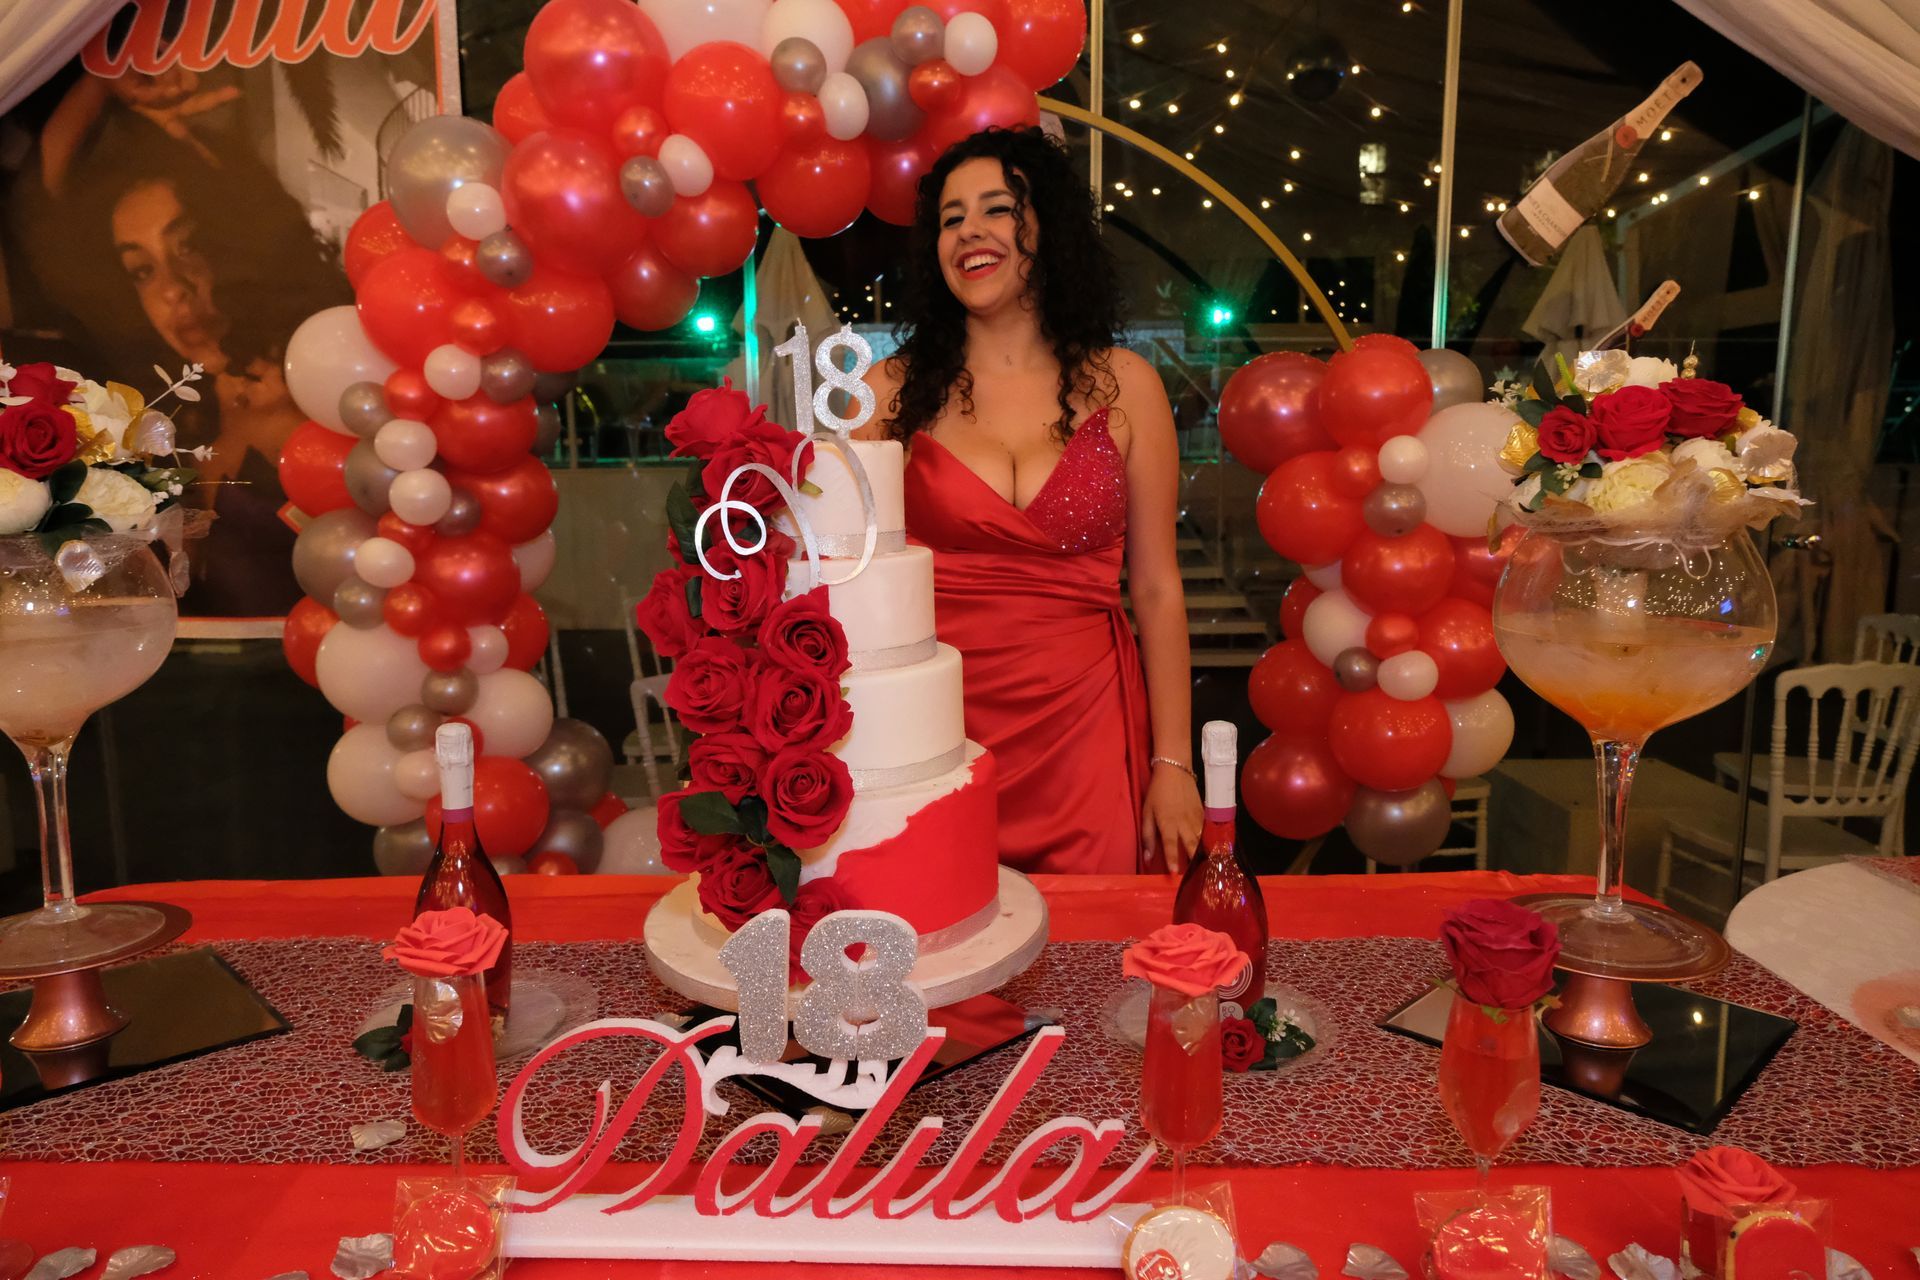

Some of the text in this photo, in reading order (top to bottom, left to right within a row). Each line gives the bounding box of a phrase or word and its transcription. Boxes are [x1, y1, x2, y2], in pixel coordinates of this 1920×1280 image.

[773, 322, 876, 440] 18
[718, 908, 929, 1068] 18
[500, 1015, 1158, 1223] Dalila
